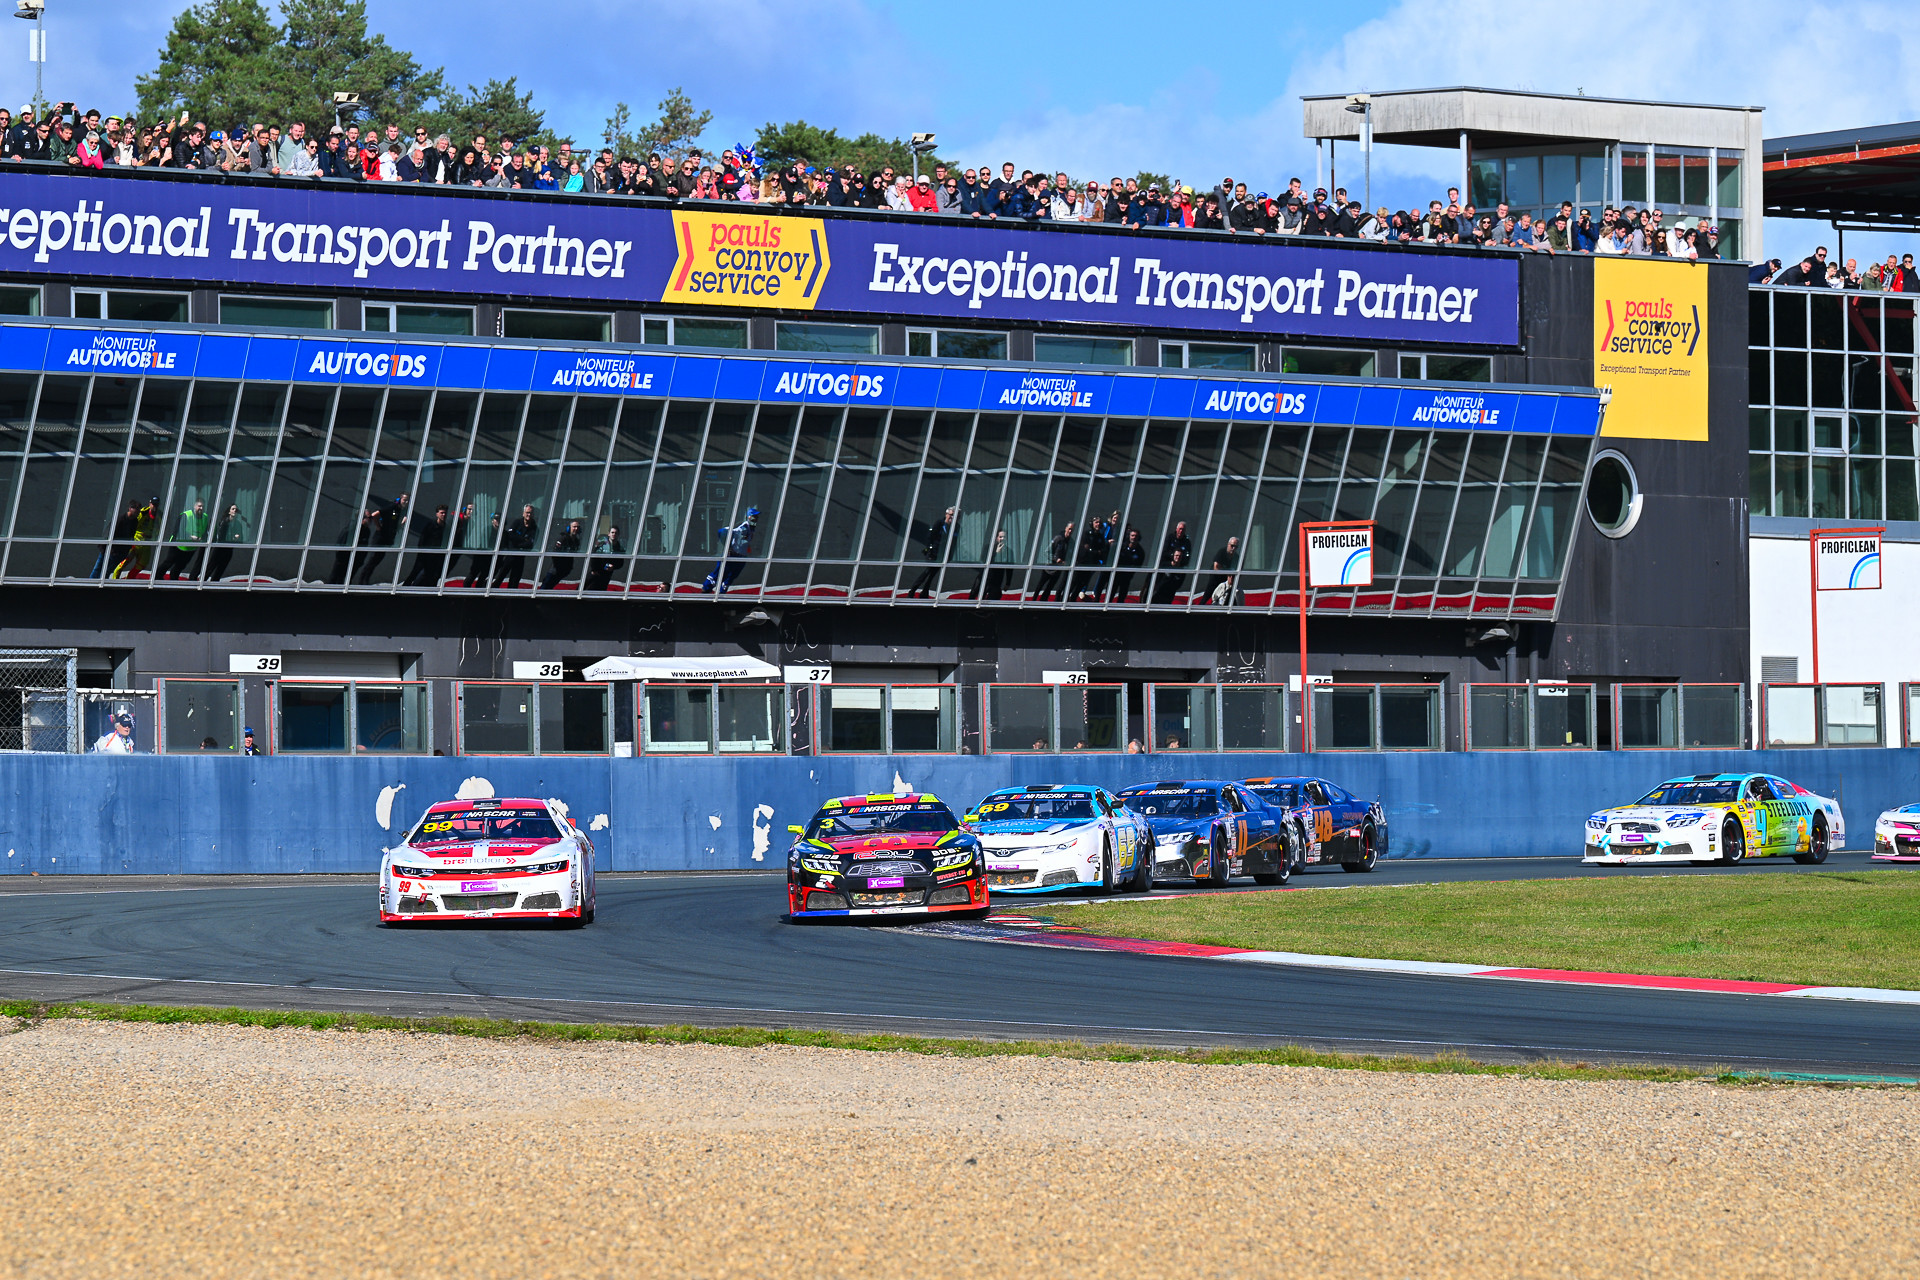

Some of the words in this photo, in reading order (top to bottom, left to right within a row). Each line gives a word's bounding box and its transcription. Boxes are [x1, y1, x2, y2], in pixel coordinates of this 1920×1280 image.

[708, 219, 782, 252] pauls
[228, 208, 452, 278] Transport
[463, 220, 632, 278] Partner
[716, 248, 809, 281] convoy
[689, 271, 781, 296] service
[869, 243, 1120, 309] Exceptional
[1134, 258, 1324, 323] Transport
[1333, 269, 1478, 322] Partner
[1624, 298, 1673, 322] pauls
[1629, 319, 1692, 343] convoy
[93, 336, 157, 351] MONITEUR
[1611, 336, 1673, 355] service
[575, 358, 635, 372] MONITEUR
[1600, 364, 1637, 374] Exceptional
[1638, 366, 1668, 376] Transport
[1669, 368, 1691, 377] Partner
[1021, 377, 1077, 392] MONITEUR
[1433, 395, 1484, 409] MONITEUR
[1312, 534, 1368, 549] PROFICLEAN
[1821, 540, 1876, 554] PROFICLEAN
[257, 658, 280, 670] 39
[540, 664, 561, 676] 38
[671, 670, 748, 678] www.raceplanet.nl
[809, 669, 830, 681] 37
[1067, 674, 1087, 684] 36
[466, 810, 516, 819] NASCAR
[863, 804, 912, 813] NASCAR
[979, 802, 1009, 814] 69
[422, 821, 453, 834] 99
[819, 818, 834, 829] 3
[1313, 810, 1333, 843] 48
[1237, 819, 1248, 856] 11
[398, 880, 412, 893] 99
